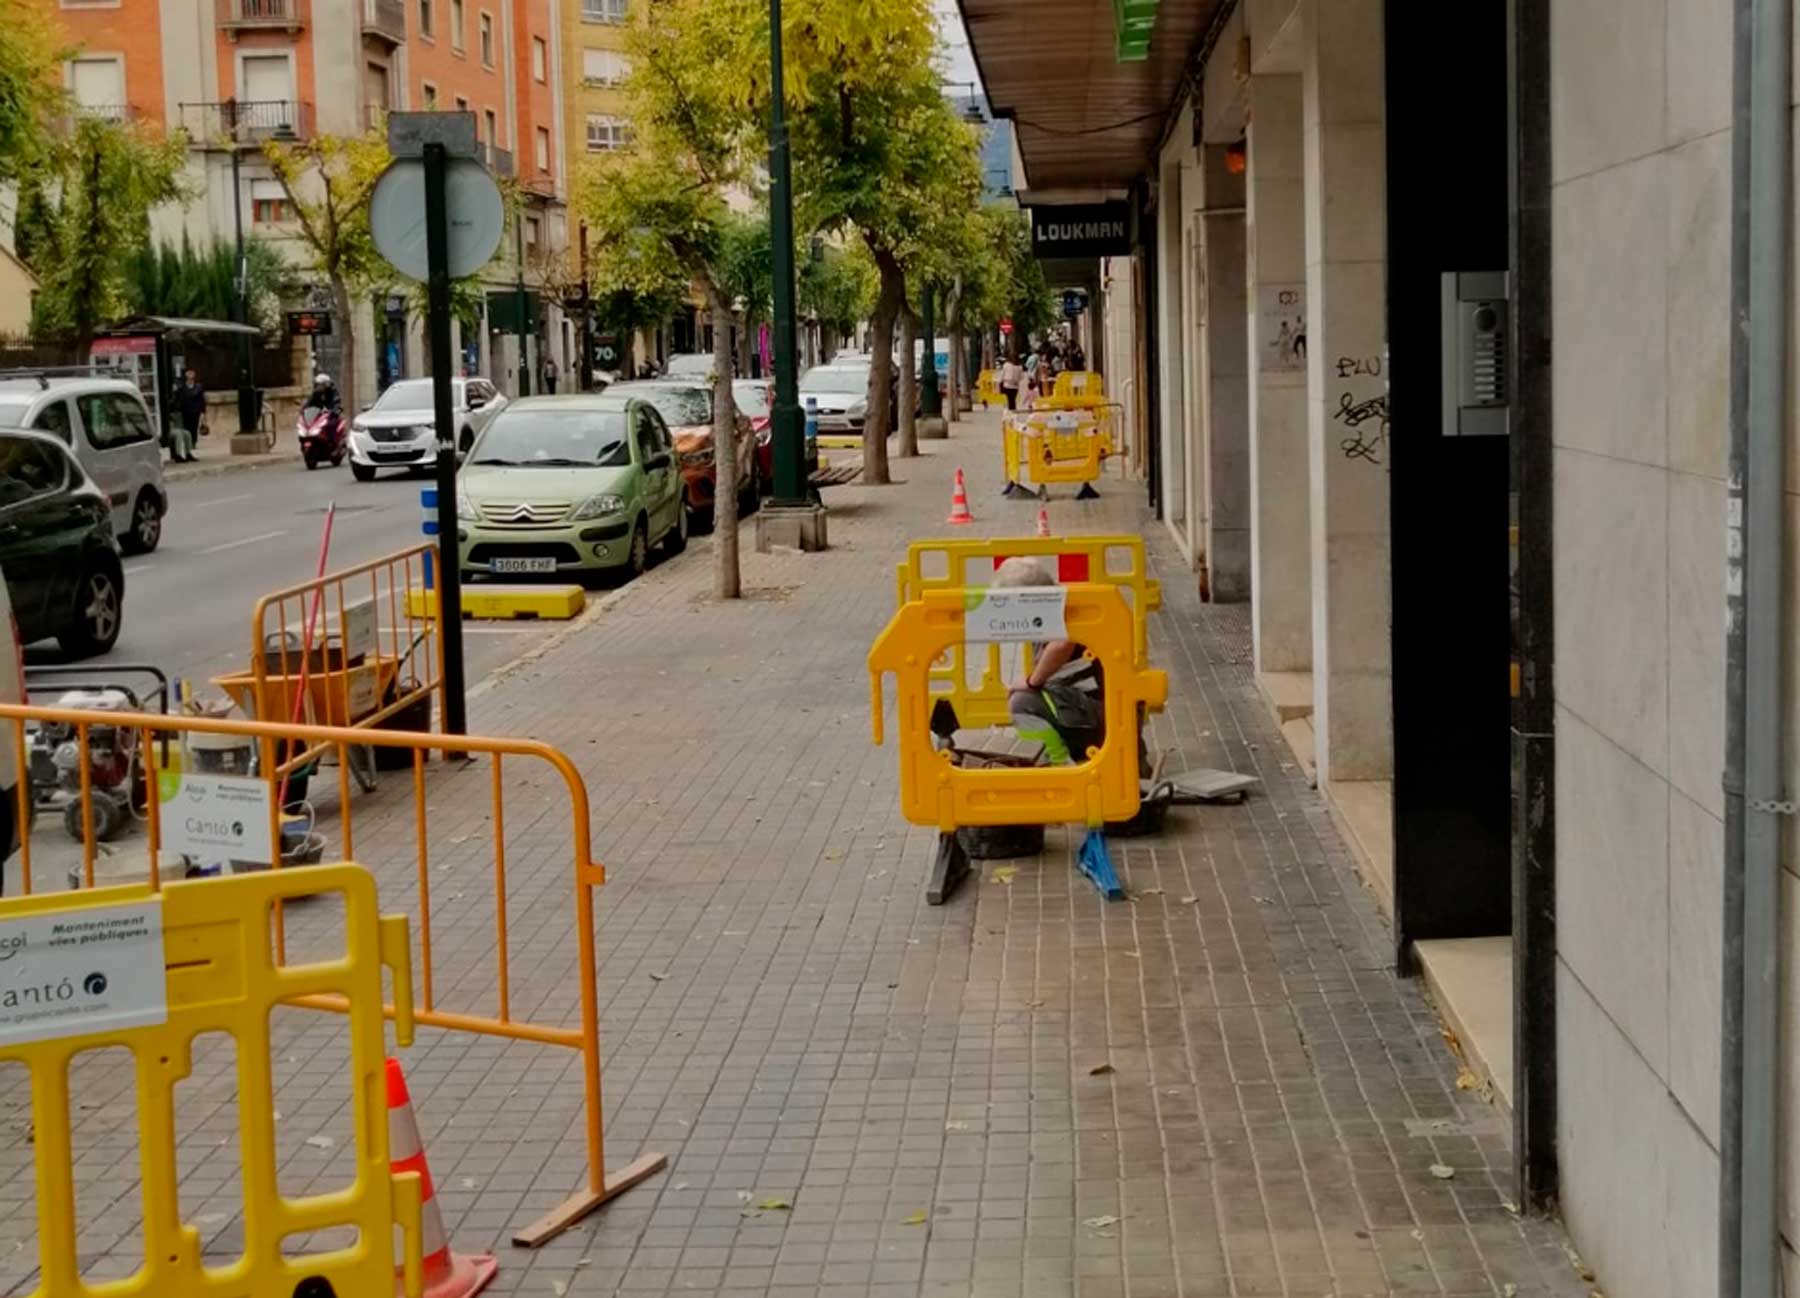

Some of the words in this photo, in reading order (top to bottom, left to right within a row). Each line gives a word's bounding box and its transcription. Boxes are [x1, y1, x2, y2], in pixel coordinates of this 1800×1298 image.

[1037, 221, 1125, 241] LOUKMAN
[0, 931, 27, 949] coi
[3, 976, 74, 1008] antó
